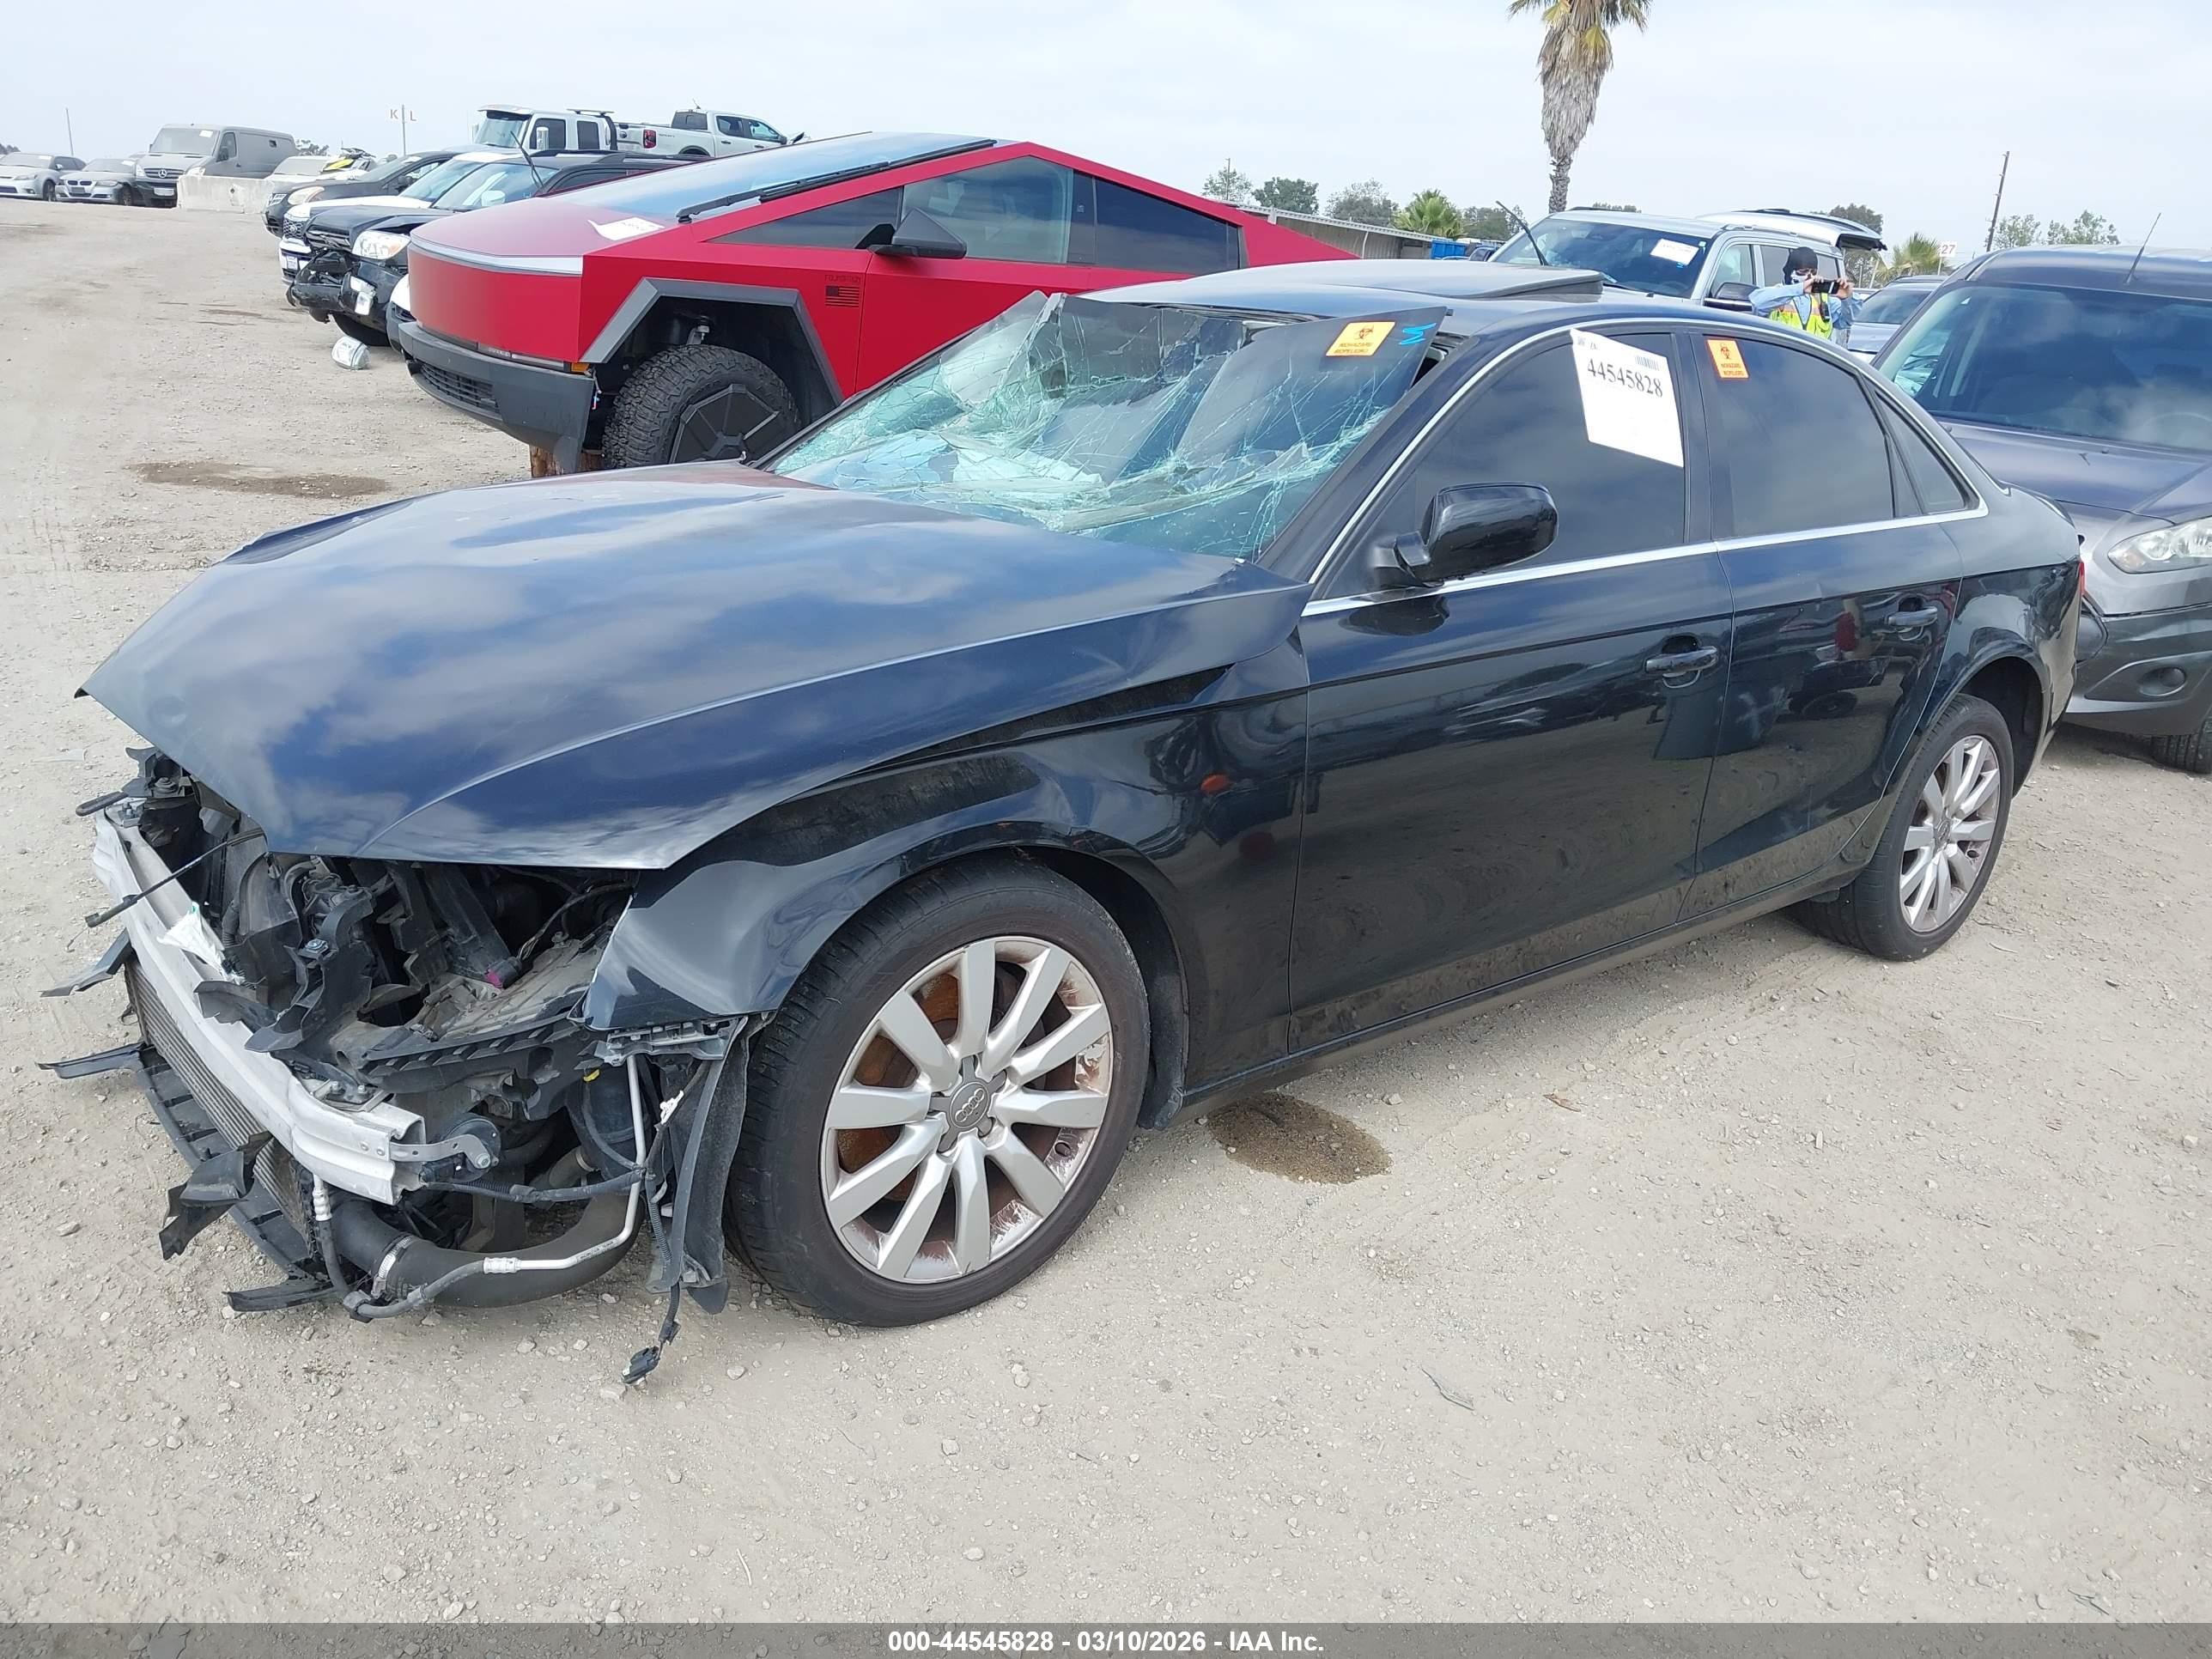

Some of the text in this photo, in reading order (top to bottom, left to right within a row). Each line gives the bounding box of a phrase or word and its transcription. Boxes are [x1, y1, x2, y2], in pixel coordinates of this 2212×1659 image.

[389, 109, 398, 119] K
[410, 110, 417, 121] L
[1942, 244, 1955, 254] 27
[1588, 359, 1663, 398] 44545828
